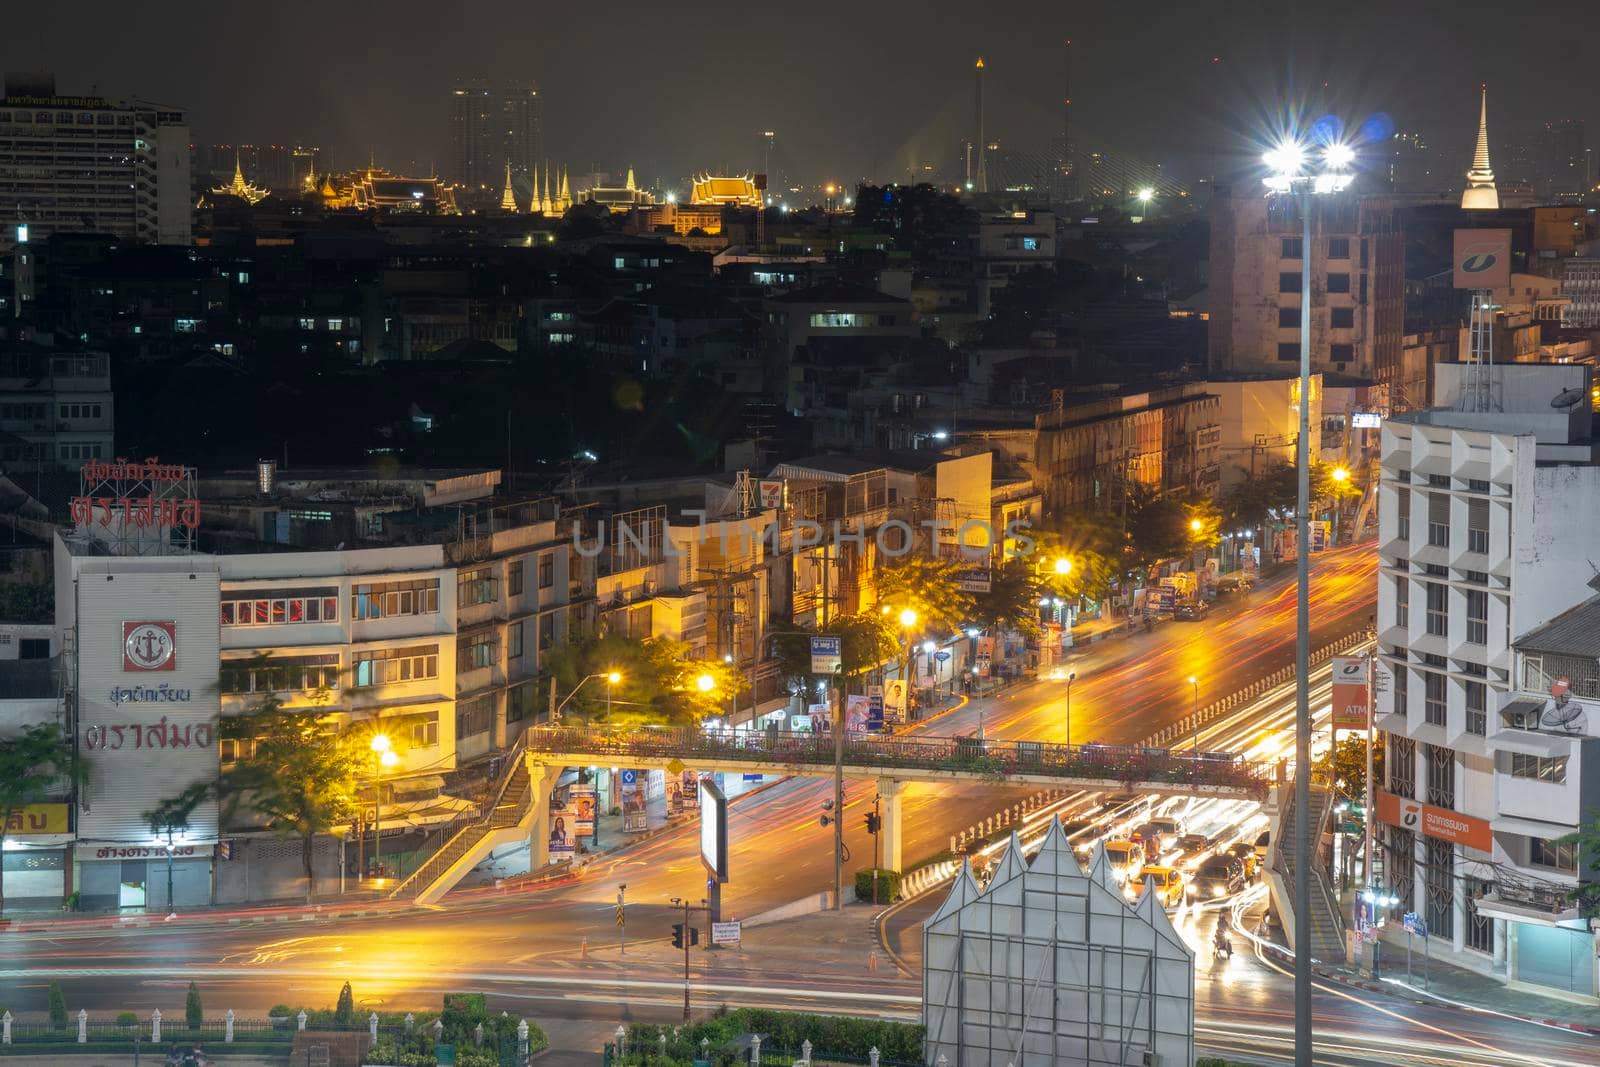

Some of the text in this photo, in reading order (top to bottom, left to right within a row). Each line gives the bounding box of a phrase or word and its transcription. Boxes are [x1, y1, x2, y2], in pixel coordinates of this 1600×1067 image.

[71, 494, 201, 529] ตราสมอ
[110, 683, 191, 708] ชุดนักเรียน
[1345, 705, 1367, 715] ATM
[85, 715, 213, 750] ตราสมอ
